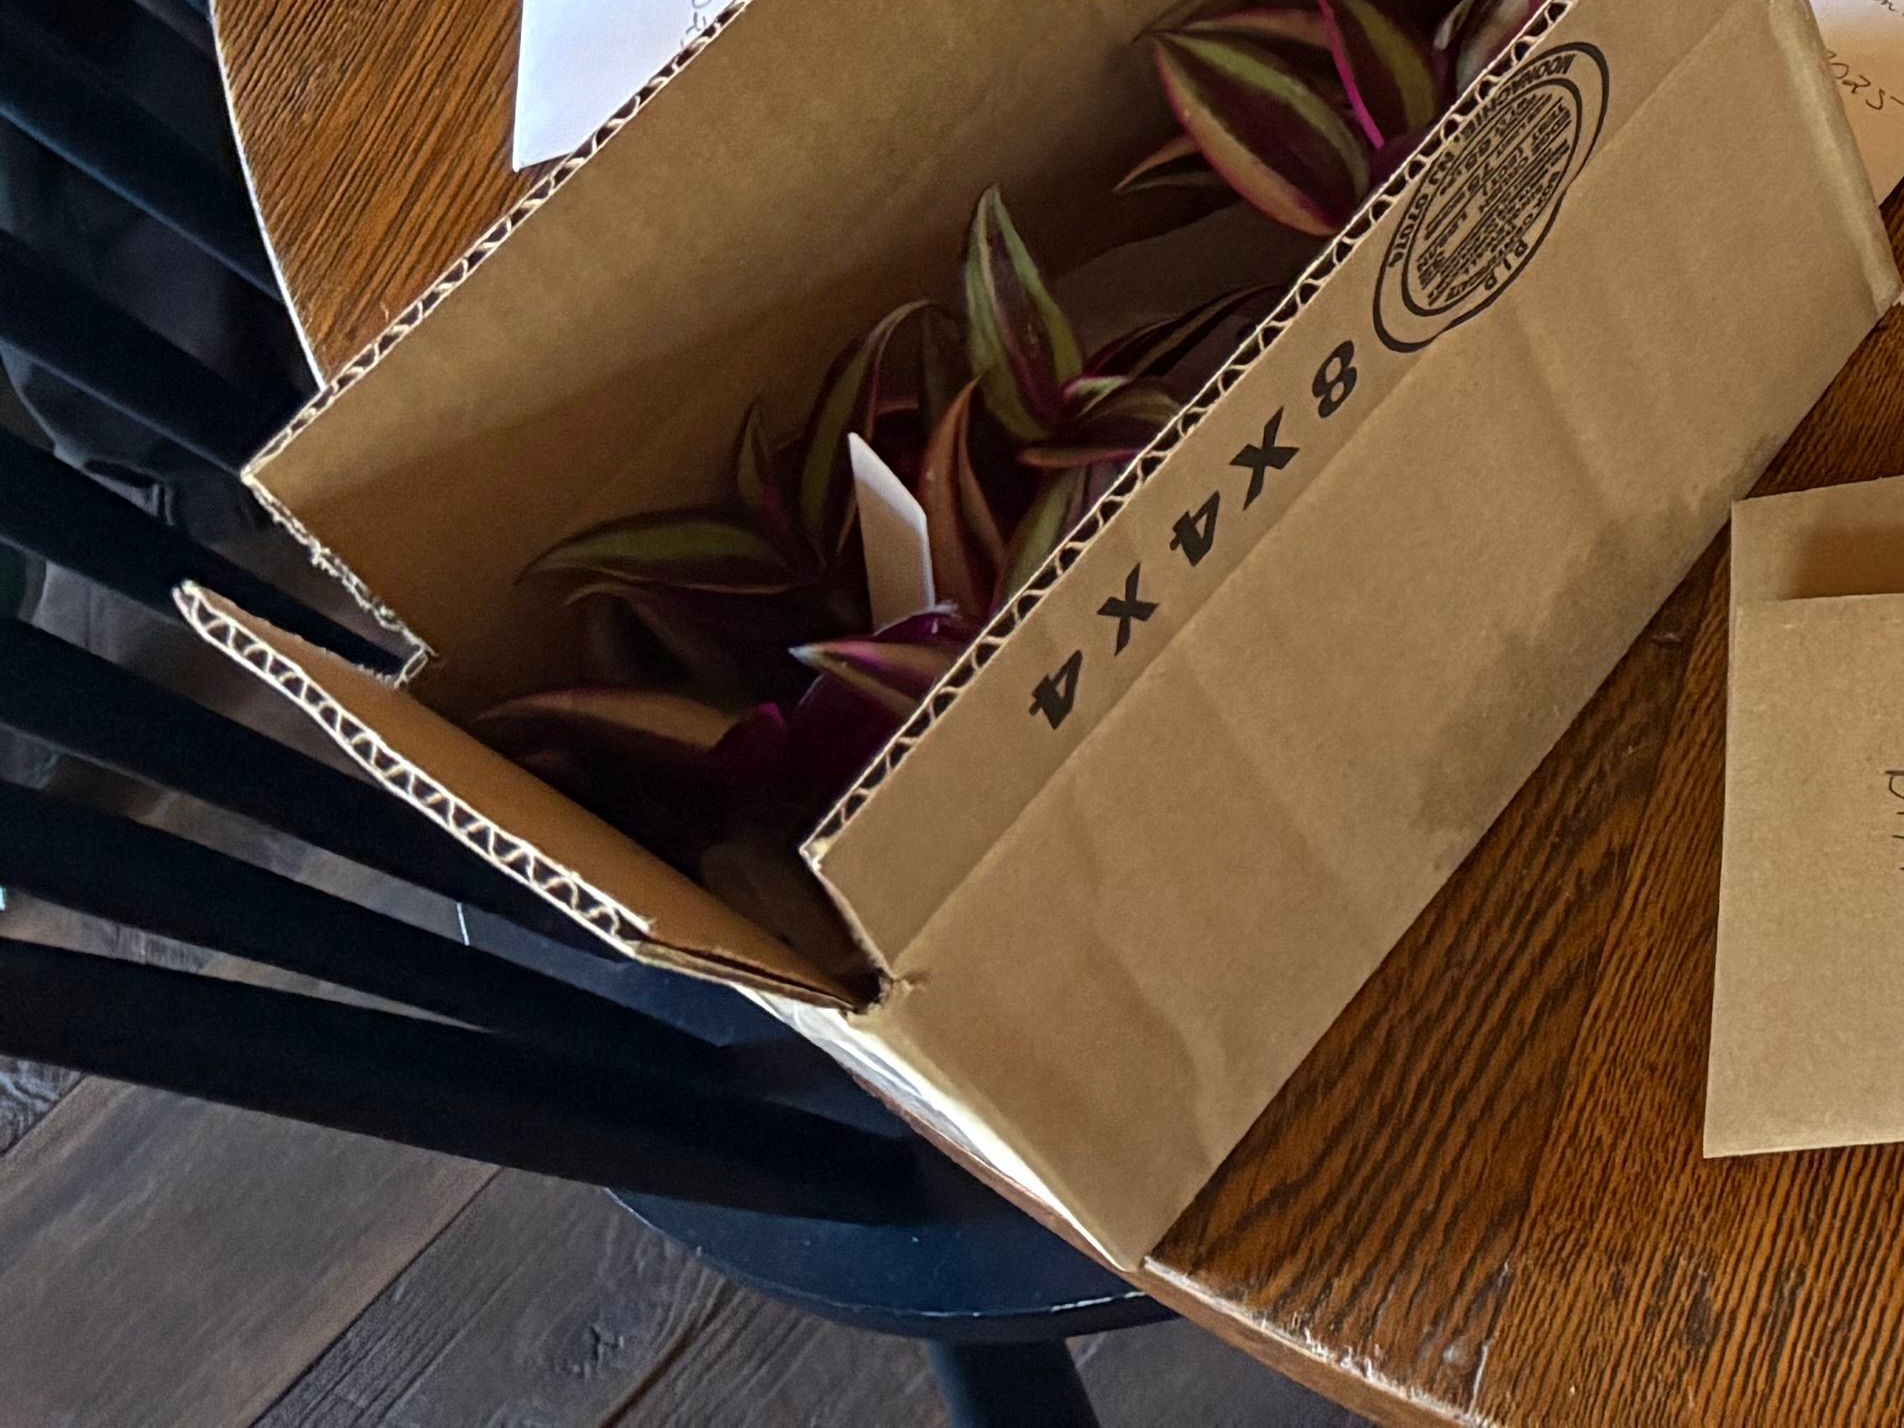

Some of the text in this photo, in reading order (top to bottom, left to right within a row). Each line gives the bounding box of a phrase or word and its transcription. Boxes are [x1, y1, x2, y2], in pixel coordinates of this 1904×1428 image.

[1028, 339, 1359, 730] 8 X 4 X 4
